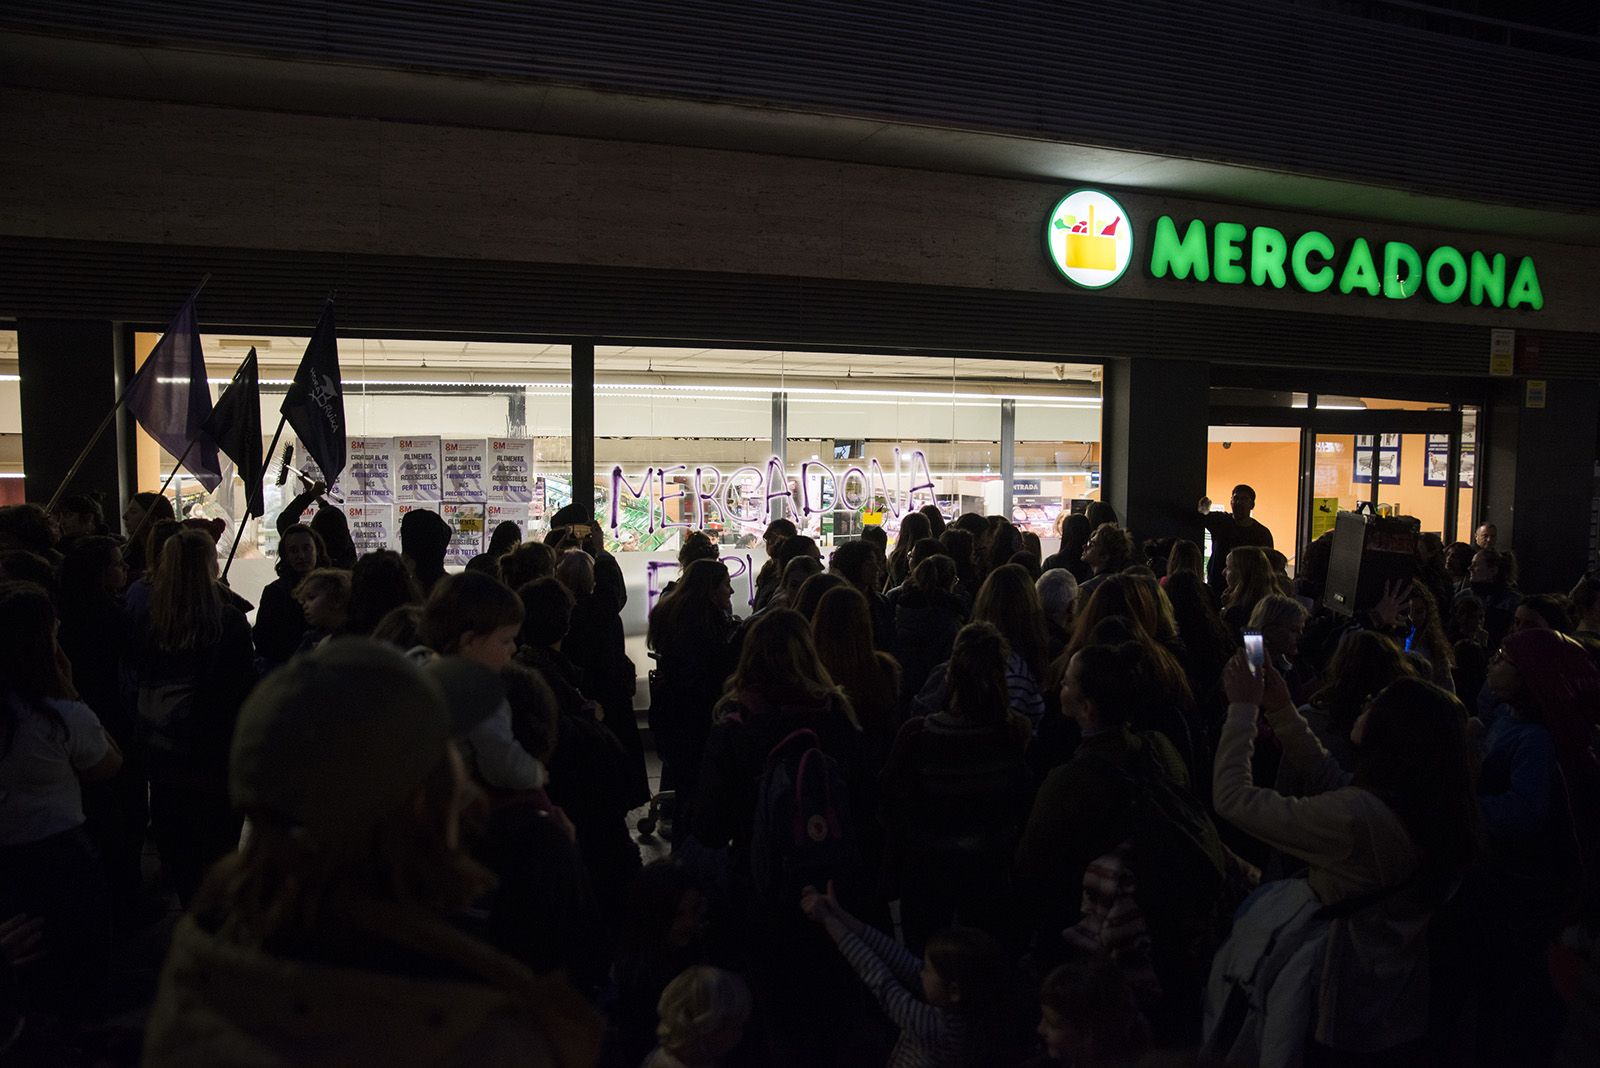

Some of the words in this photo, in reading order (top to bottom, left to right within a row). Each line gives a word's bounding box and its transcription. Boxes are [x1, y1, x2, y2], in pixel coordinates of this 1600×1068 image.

[1150, 215, 1544, 310] MERCADONA
[351, 441, 365, 449] 8M
[400, 440, 412, 448] 8M
[445, 443, 458, 451] 8M
[493, 441, 505, 450] 8M
[611, 448, 937, 538] MERCADONA
[349, 508, 362, 516] 8M
[399, 505, 412, 513] 8M
[444, 504, 457, 513] 8M
[488, 506, 501, 514] 8M
